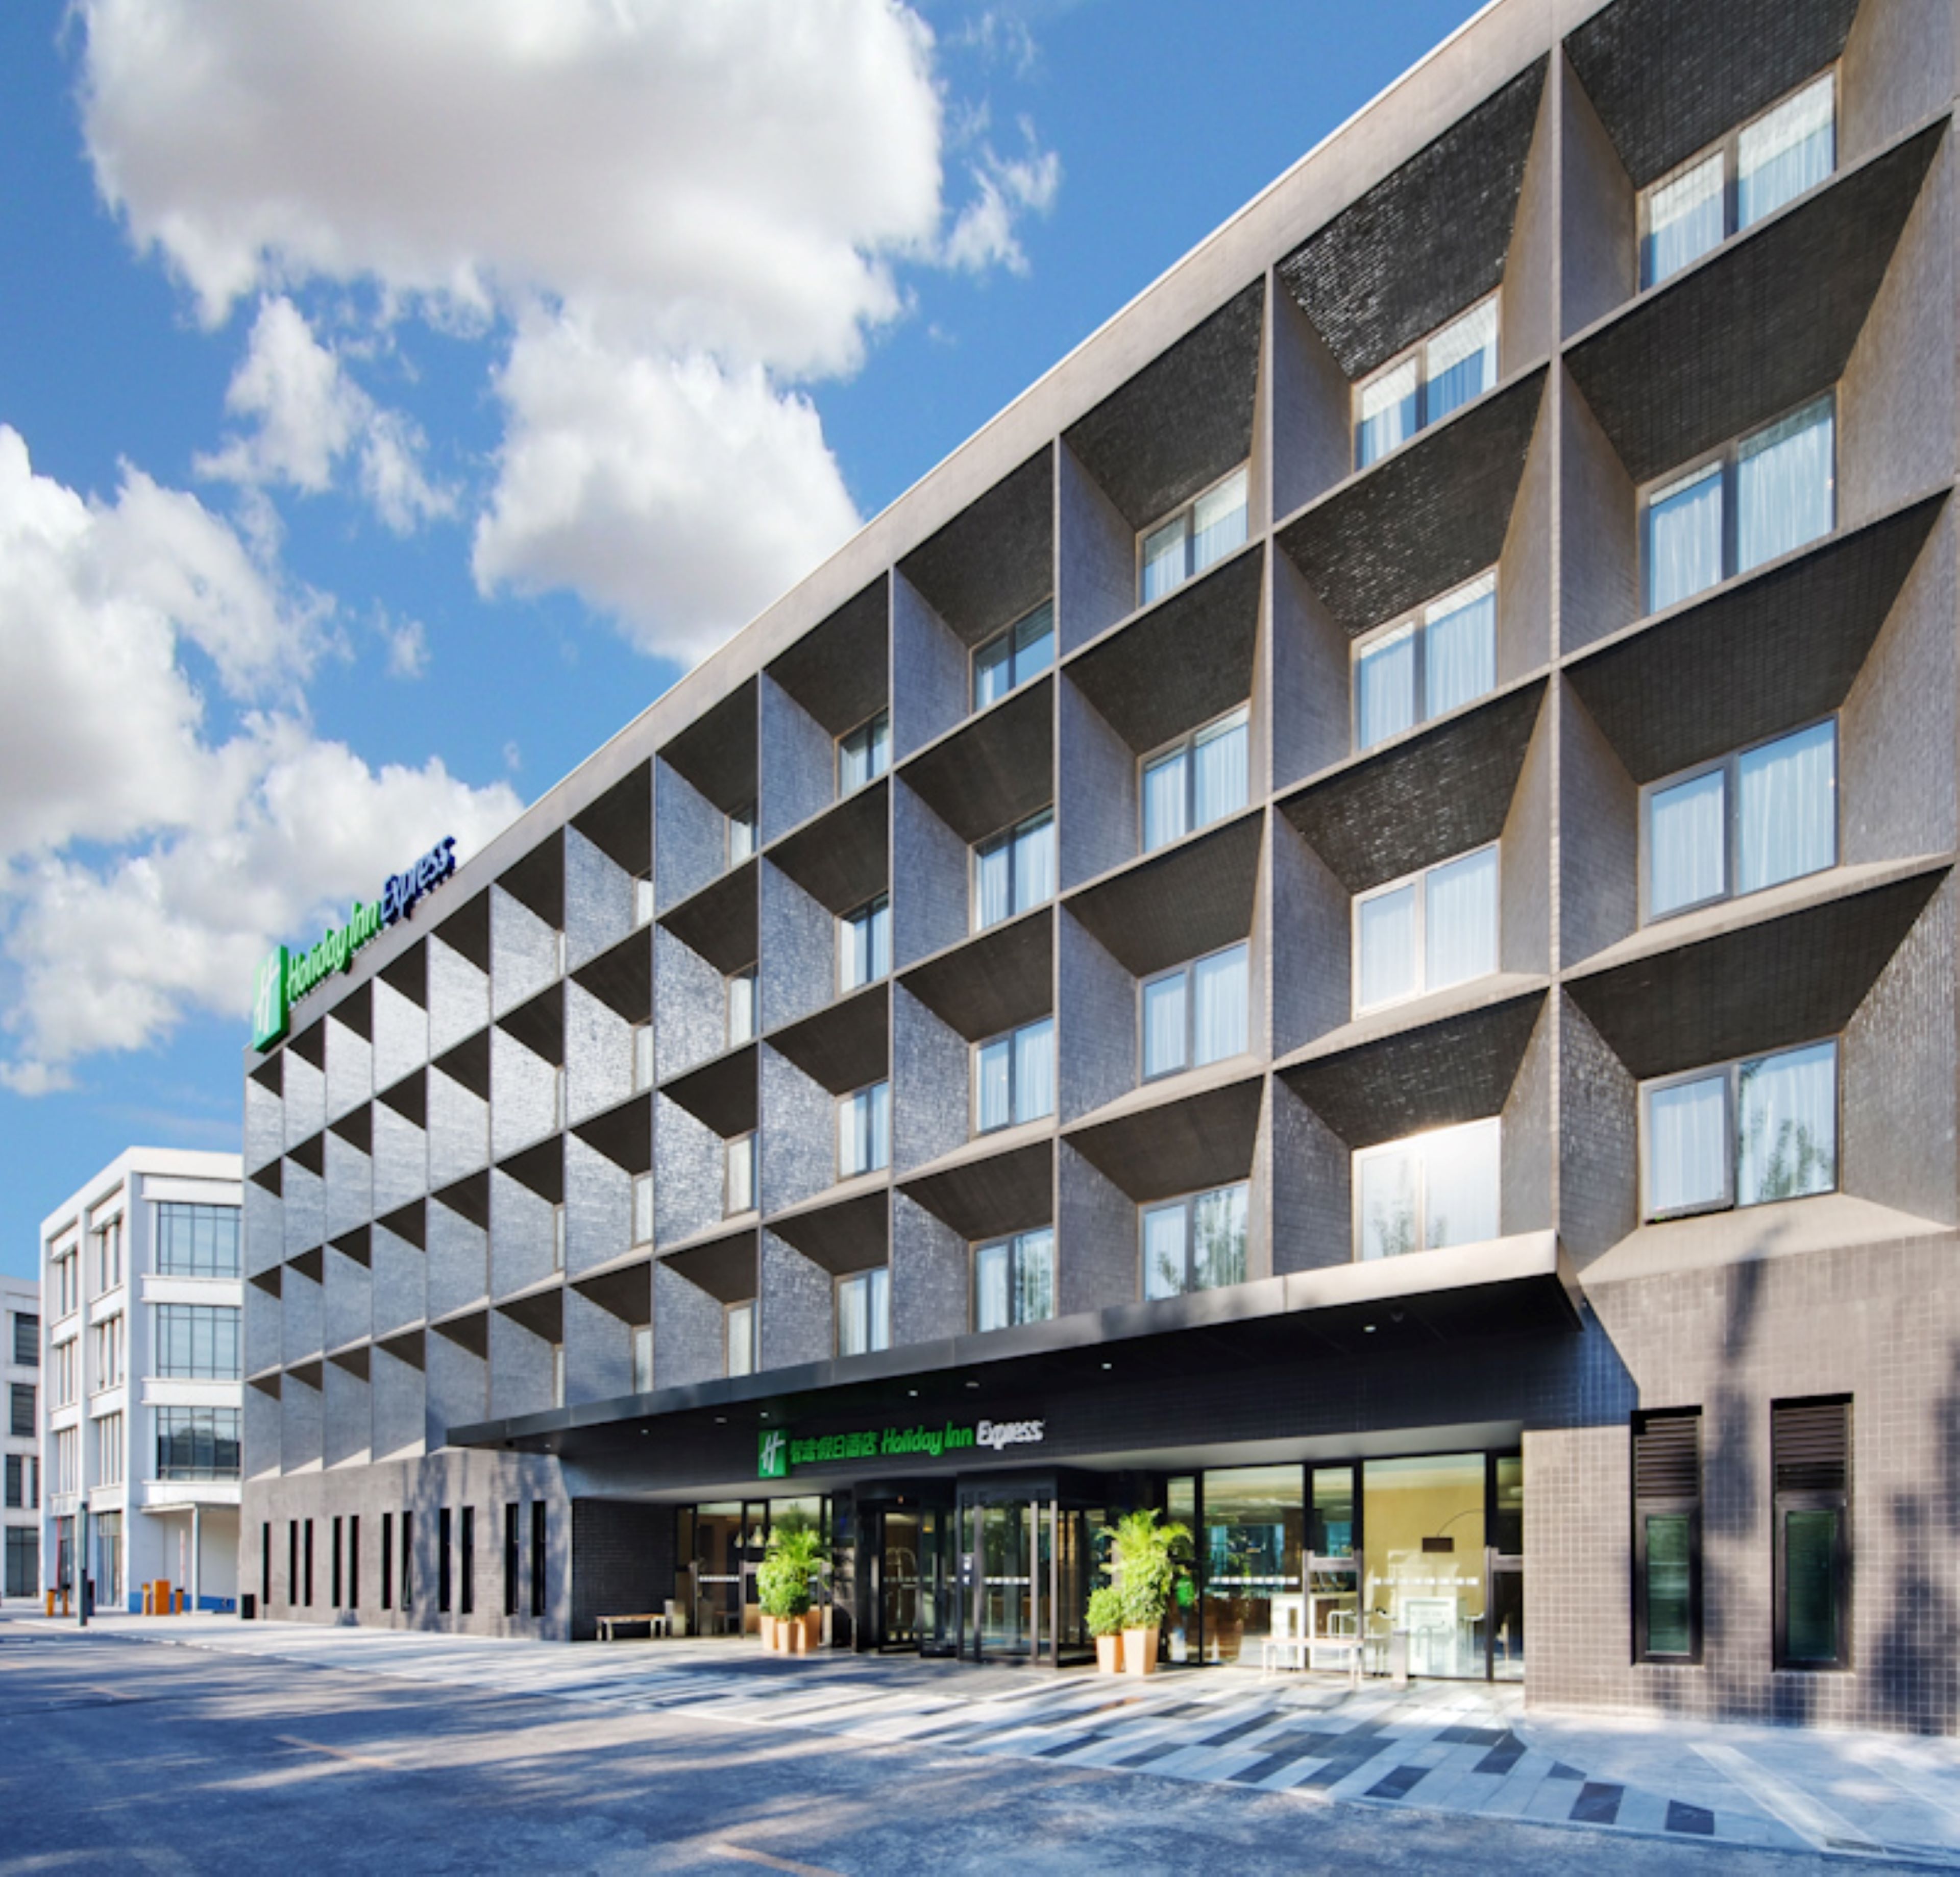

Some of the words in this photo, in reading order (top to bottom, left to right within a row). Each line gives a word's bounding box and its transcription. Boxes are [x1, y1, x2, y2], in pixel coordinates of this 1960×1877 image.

[287, 928, 353, 1001] Holiday
[349, 900, 383, 949] Inn
[381, 835, 456, 923] Express
[881, 1427, 944, 1456] Holiday
[945, 1421, 973, 1448] Inn
[976, 1420, 1044, 1450] Express
